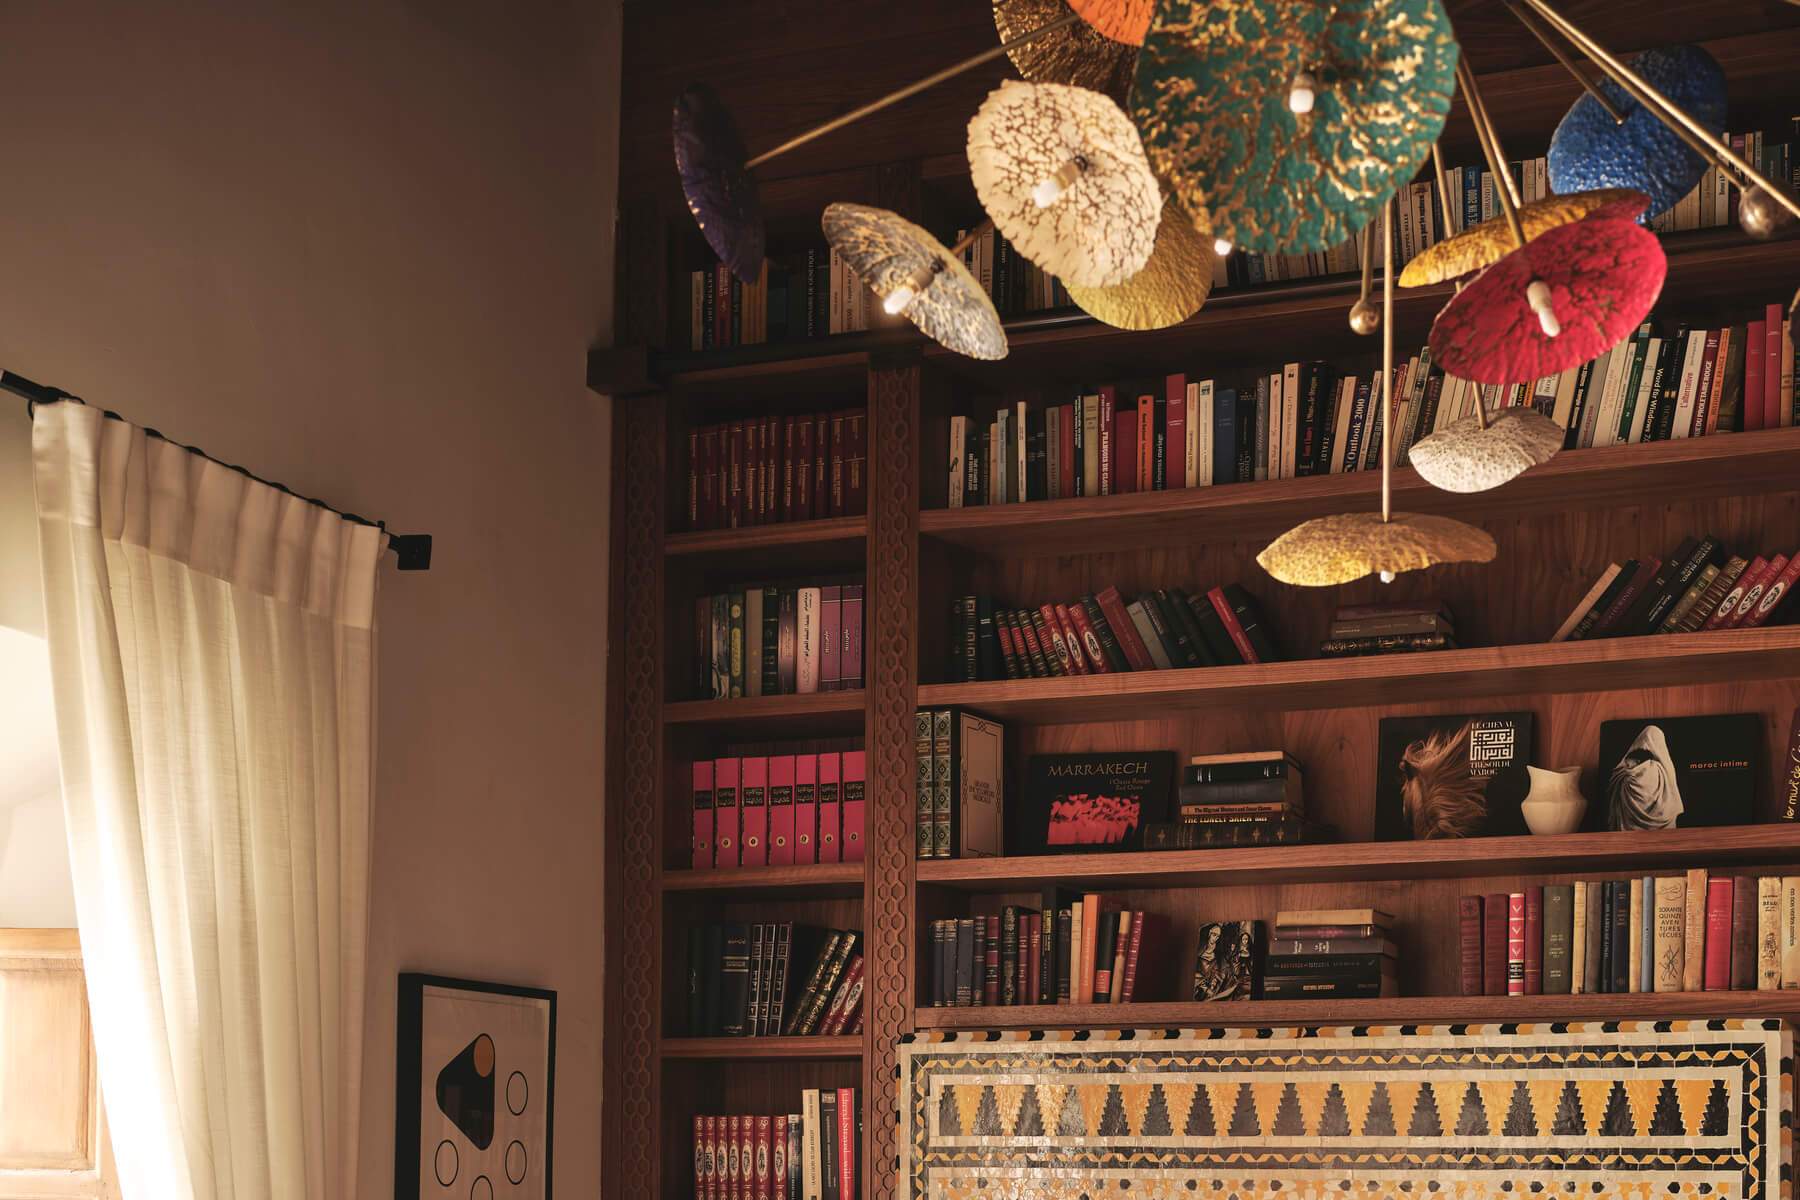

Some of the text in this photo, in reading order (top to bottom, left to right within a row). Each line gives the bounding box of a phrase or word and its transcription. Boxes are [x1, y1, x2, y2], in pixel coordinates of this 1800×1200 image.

[1466, 189, 1477, 204] 2000
[1704, 360, 1712, 380] ROUGE
[1644, 368, 1664, 432] Word für Windows
[1680, 372, 1693, 408] L'alternative
[1347, 399, 1366, 460] Outlook 2000
[1321, 437, 1330, 462] ZEALOT
[1102, 463, 1108, 472] DE
[1048, 762, 1147, 776] MARRAKECH
[1787, 779, 1799, 804] must
[1782, 806, 1795, 819] les
[1790, 888, 1795, 896] en
[843, 1123, 851, 1153] Strayed
[843, 1160, 851, 1179] wild
